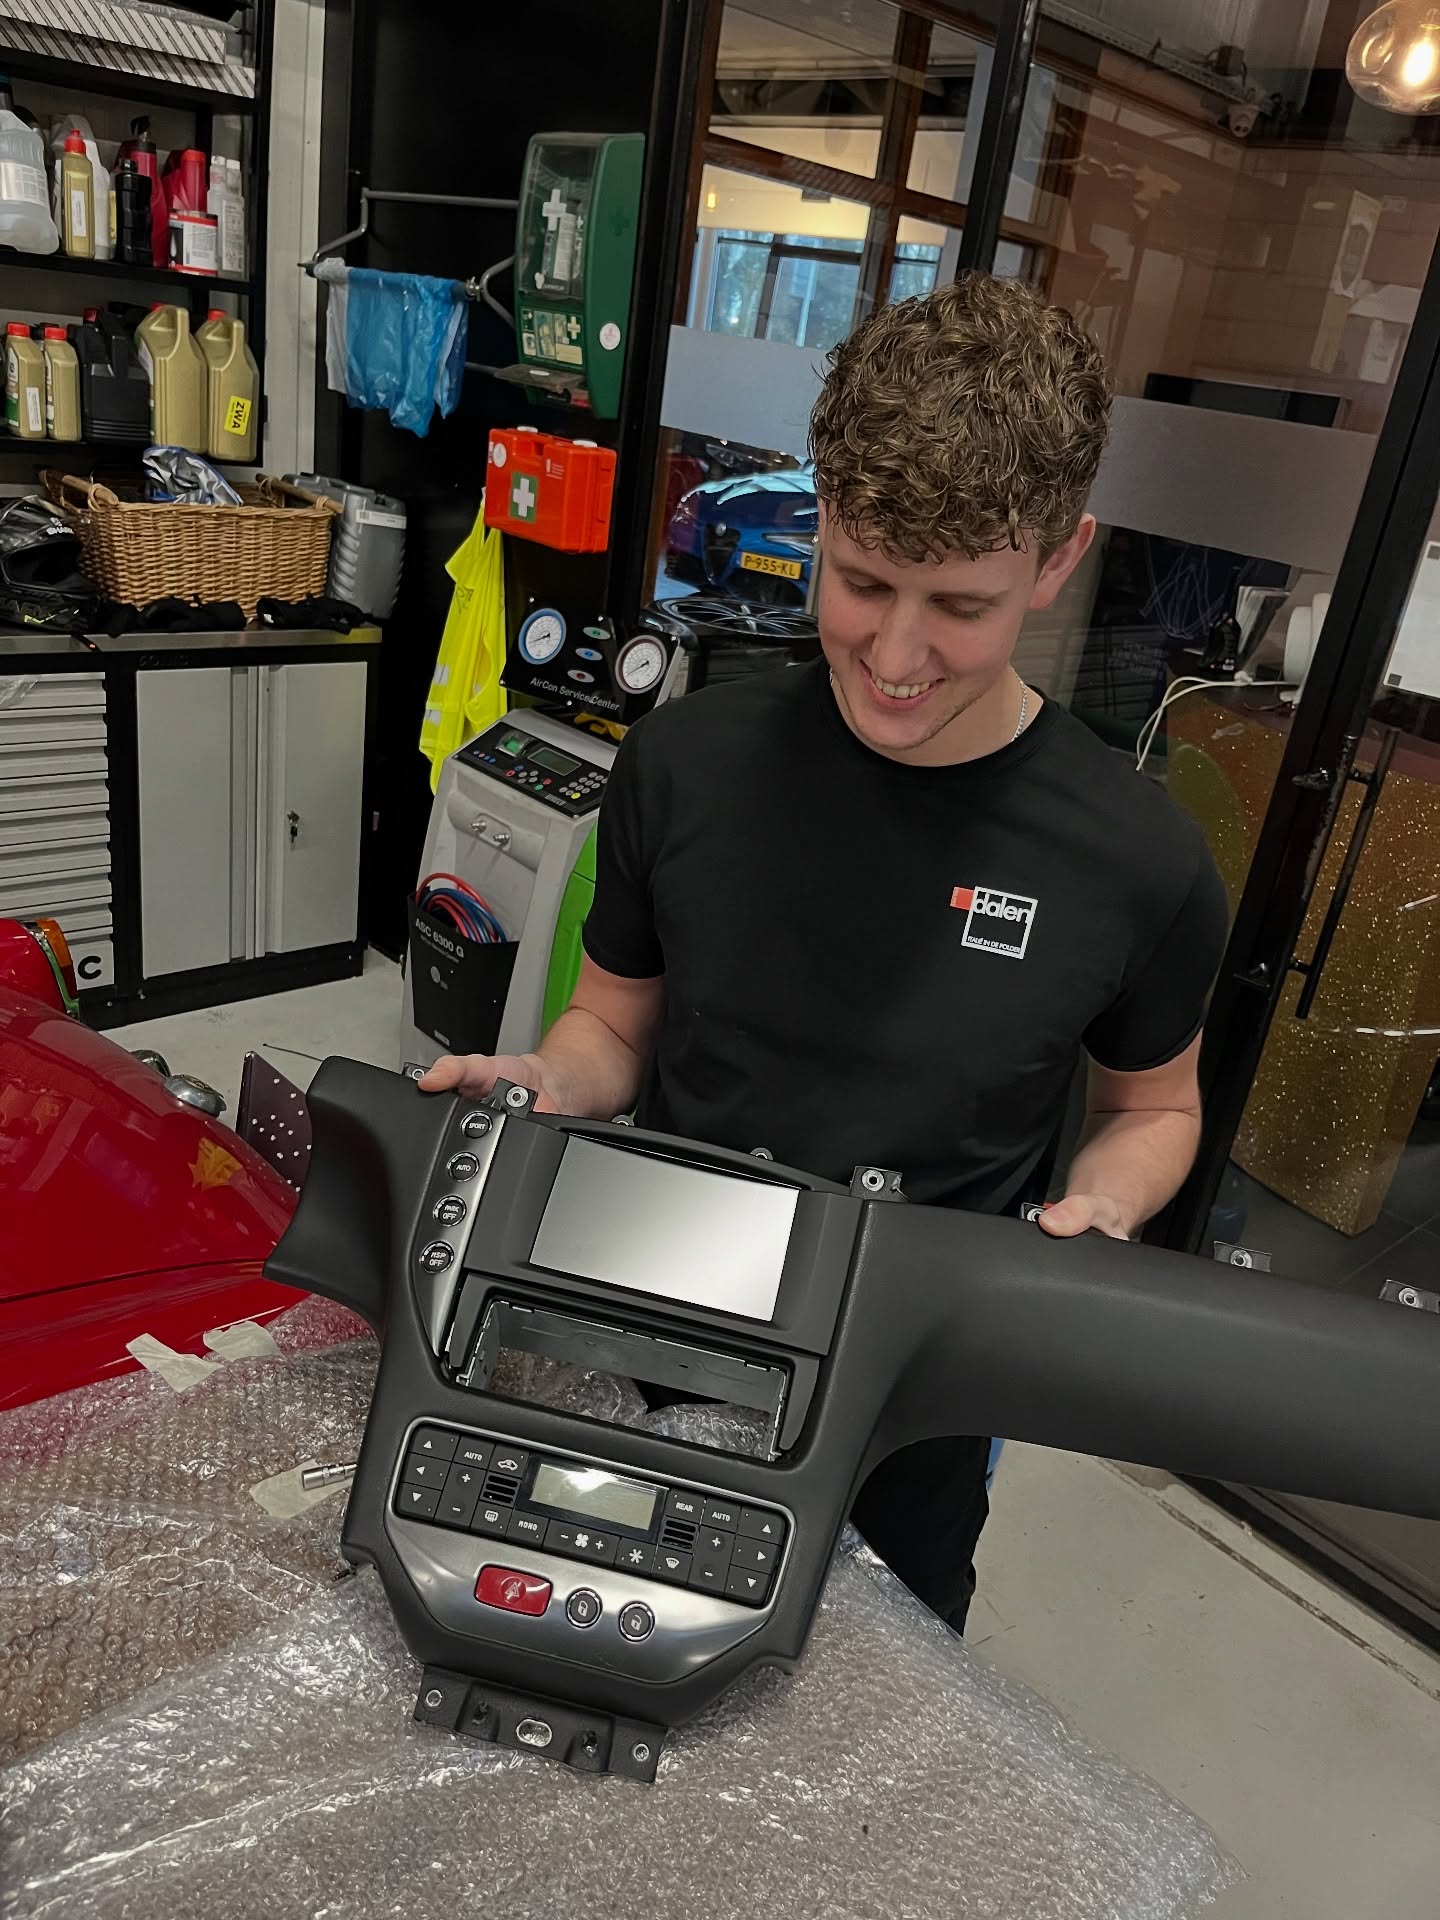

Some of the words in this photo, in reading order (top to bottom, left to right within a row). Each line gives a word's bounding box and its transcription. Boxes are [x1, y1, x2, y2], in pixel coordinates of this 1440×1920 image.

[232, 401, 245, 429] ZWA
[529, 676, 559, 693] AirCon
[559, 686, 591, 703] Service
[591, 696, 620, 712] Center
[973, 892, 1029, 924] dalen
[415, 918, 432, 937] ASC
[433, 931, 454, 952] 6300
[77, 955, 102, 980] C
[468, 1122, 486, 1130] SPORT
[456, 1164, 472, 1172] AUTO
[442, 1212, 457, 1220] OFF
[429, 1258, 444, 1267] OFF
[463, 1451, 483, 1461] AUTO
[675, 1502, 694, 1513] REAR
[711, 1511, 731, 1522] AUTO
[518, 1520, 538, 1531] MONO
